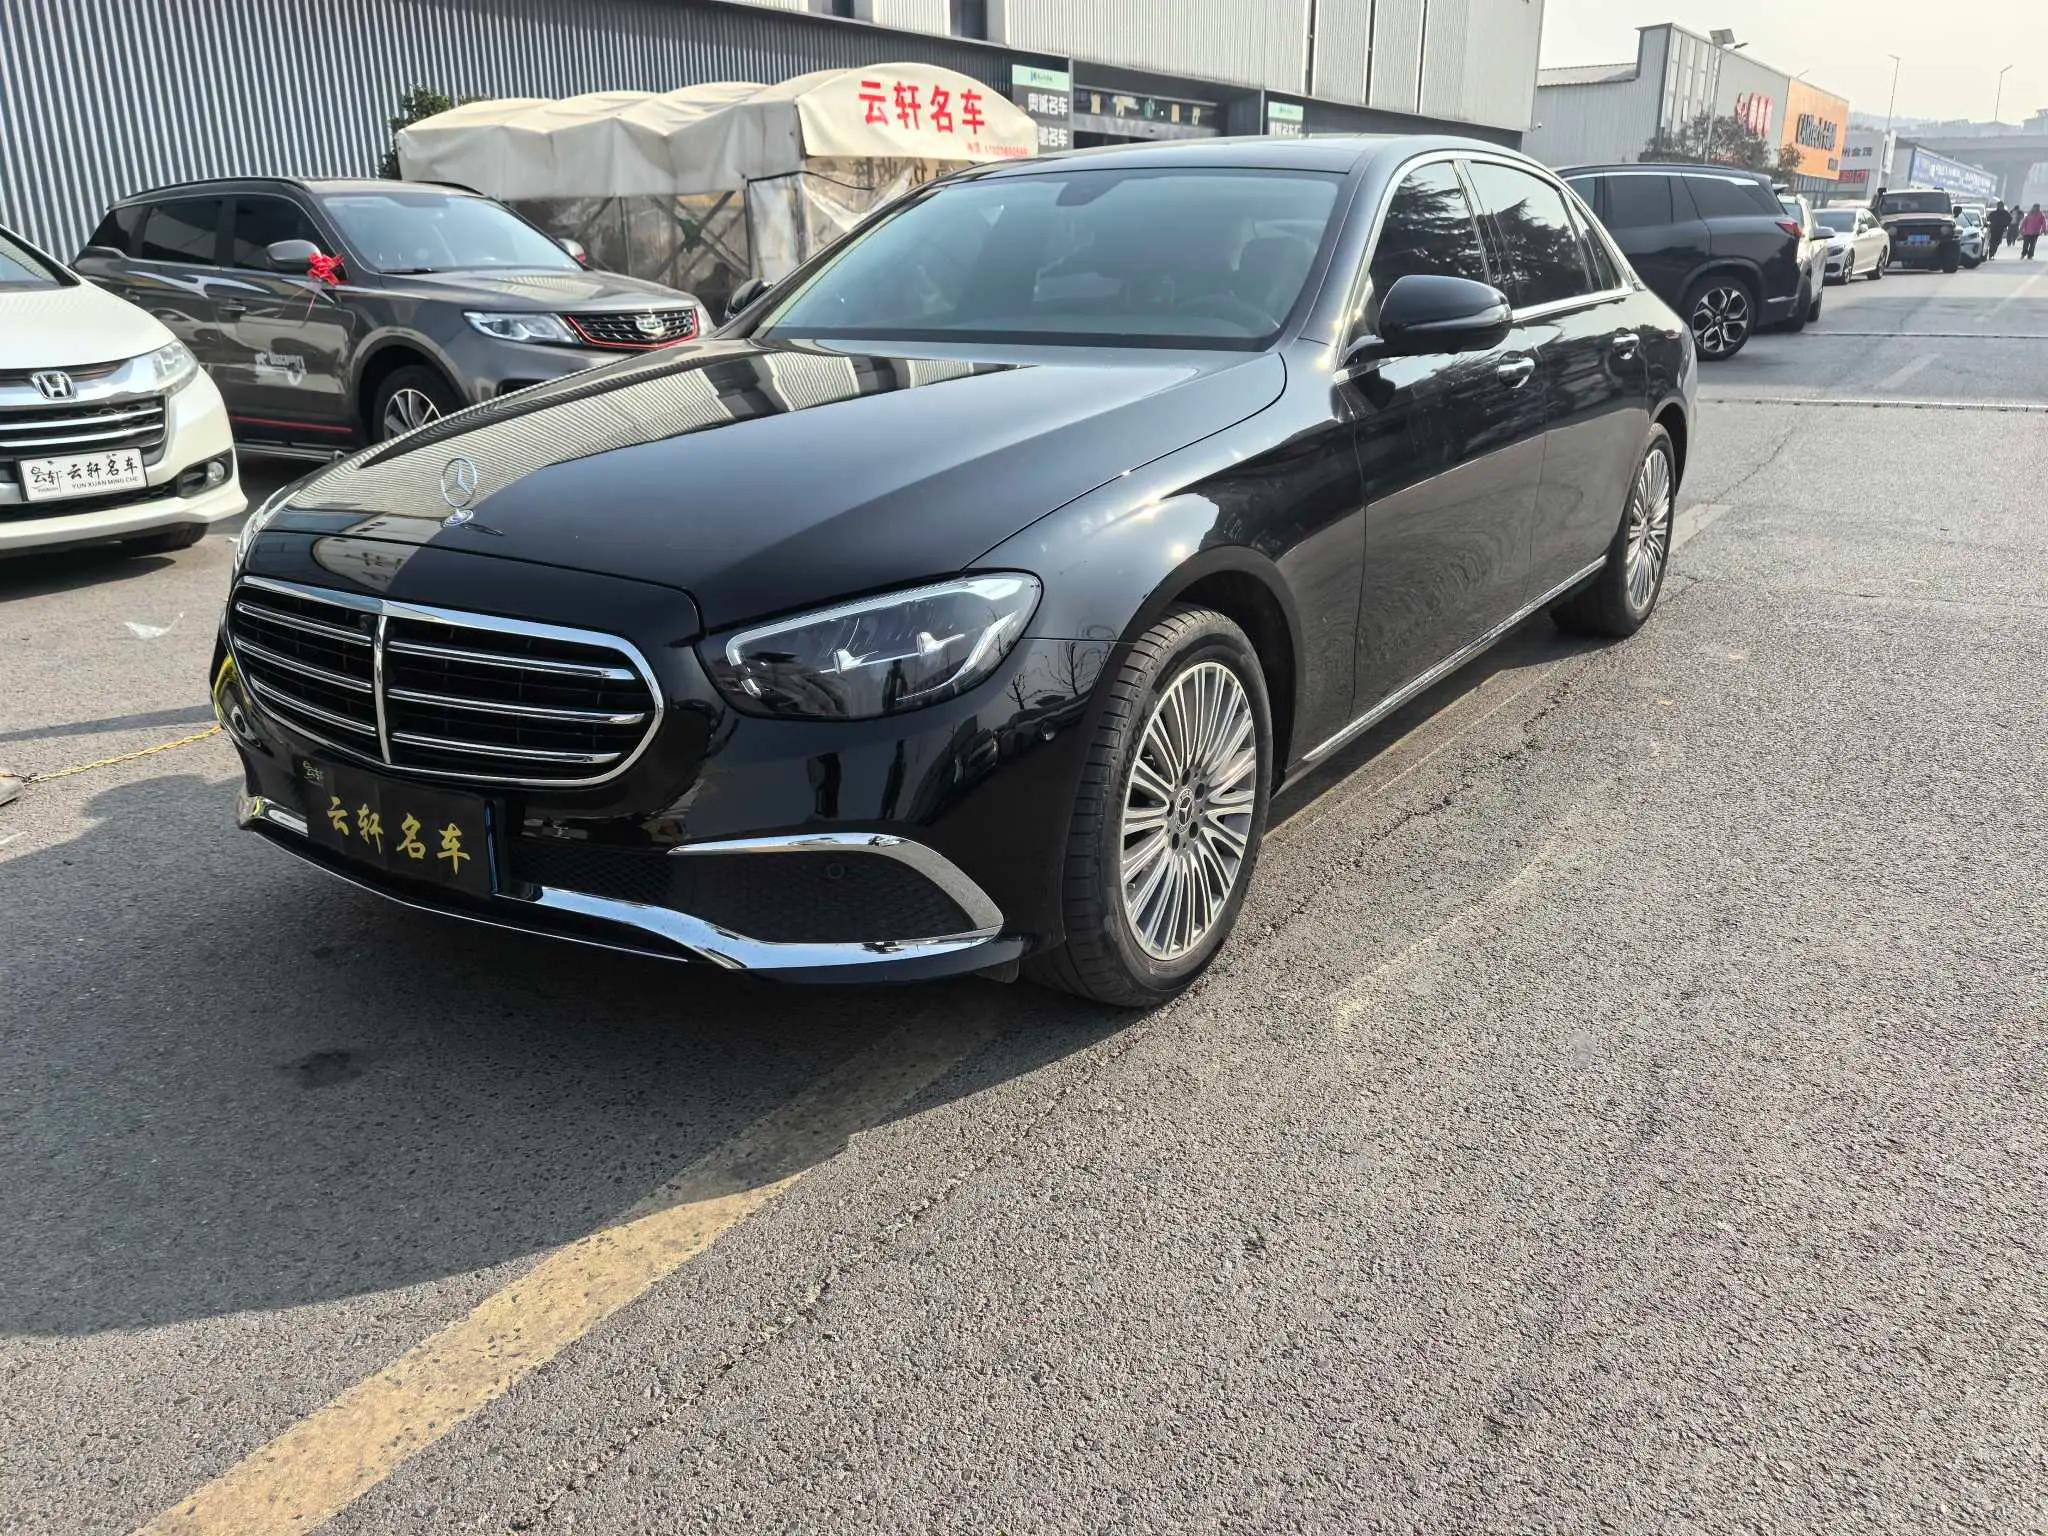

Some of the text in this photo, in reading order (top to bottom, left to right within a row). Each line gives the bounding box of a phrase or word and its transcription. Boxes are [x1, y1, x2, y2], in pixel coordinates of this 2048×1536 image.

[858, 80, 985, 135] 云轩名车
[67, 456, 138, 480] 云轩名车
[327, 796, 471, 875] 云轩名车
